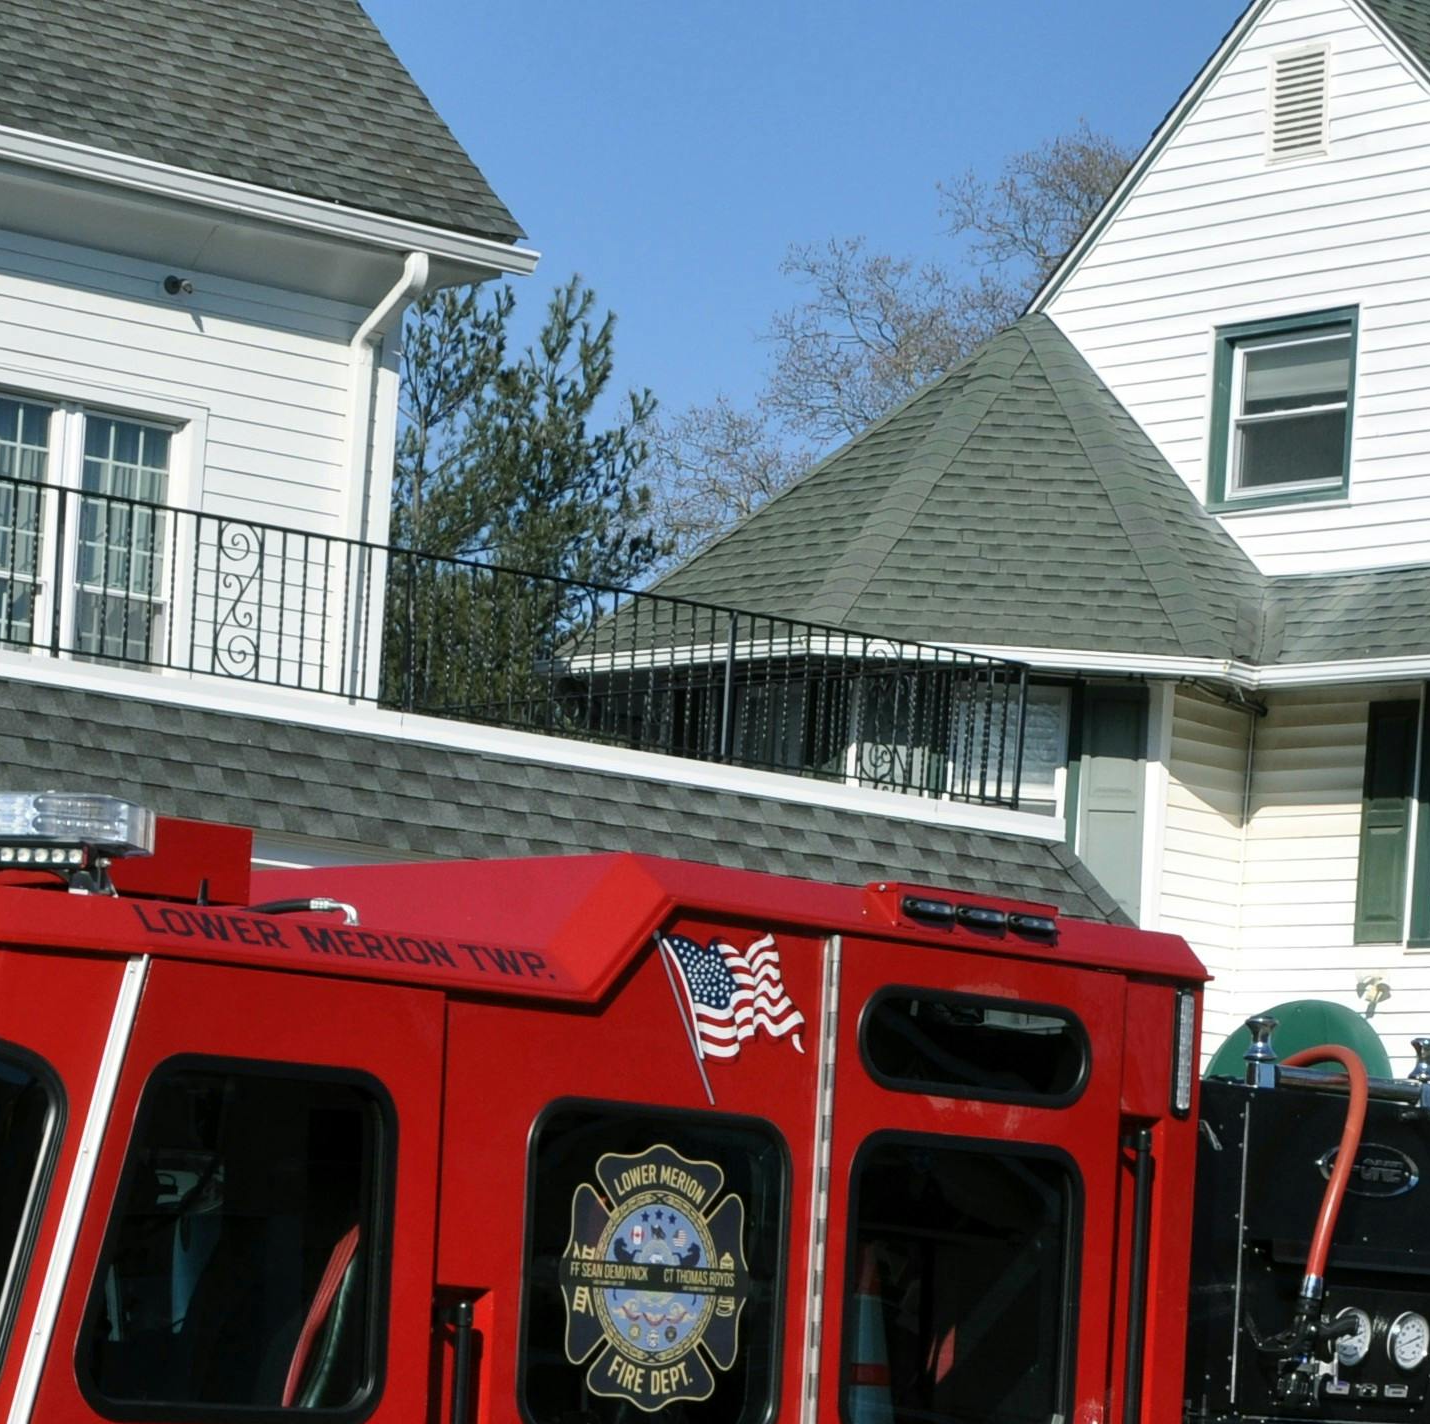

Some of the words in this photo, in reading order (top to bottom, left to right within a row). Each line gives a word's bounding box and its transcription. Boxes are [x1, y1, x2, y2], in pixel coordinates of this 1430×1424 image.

[132, 903, 289, 949] LOWER
[296, 923, 457, 968] MERION
[458, 942, 557, 980] TWP.
[613, 1163, 657, 1197] LOWER
[659, 1164, 706, 1206] MERION
[570, 1262, 580, 1276] FF
[581, 1262, 603, 1278] SEAN
[676, 1269, 708, 1286] THOMAS
[607, 1357, 644, 1394] FIRE
[650, 1360, 694, 1396] DEPT.
